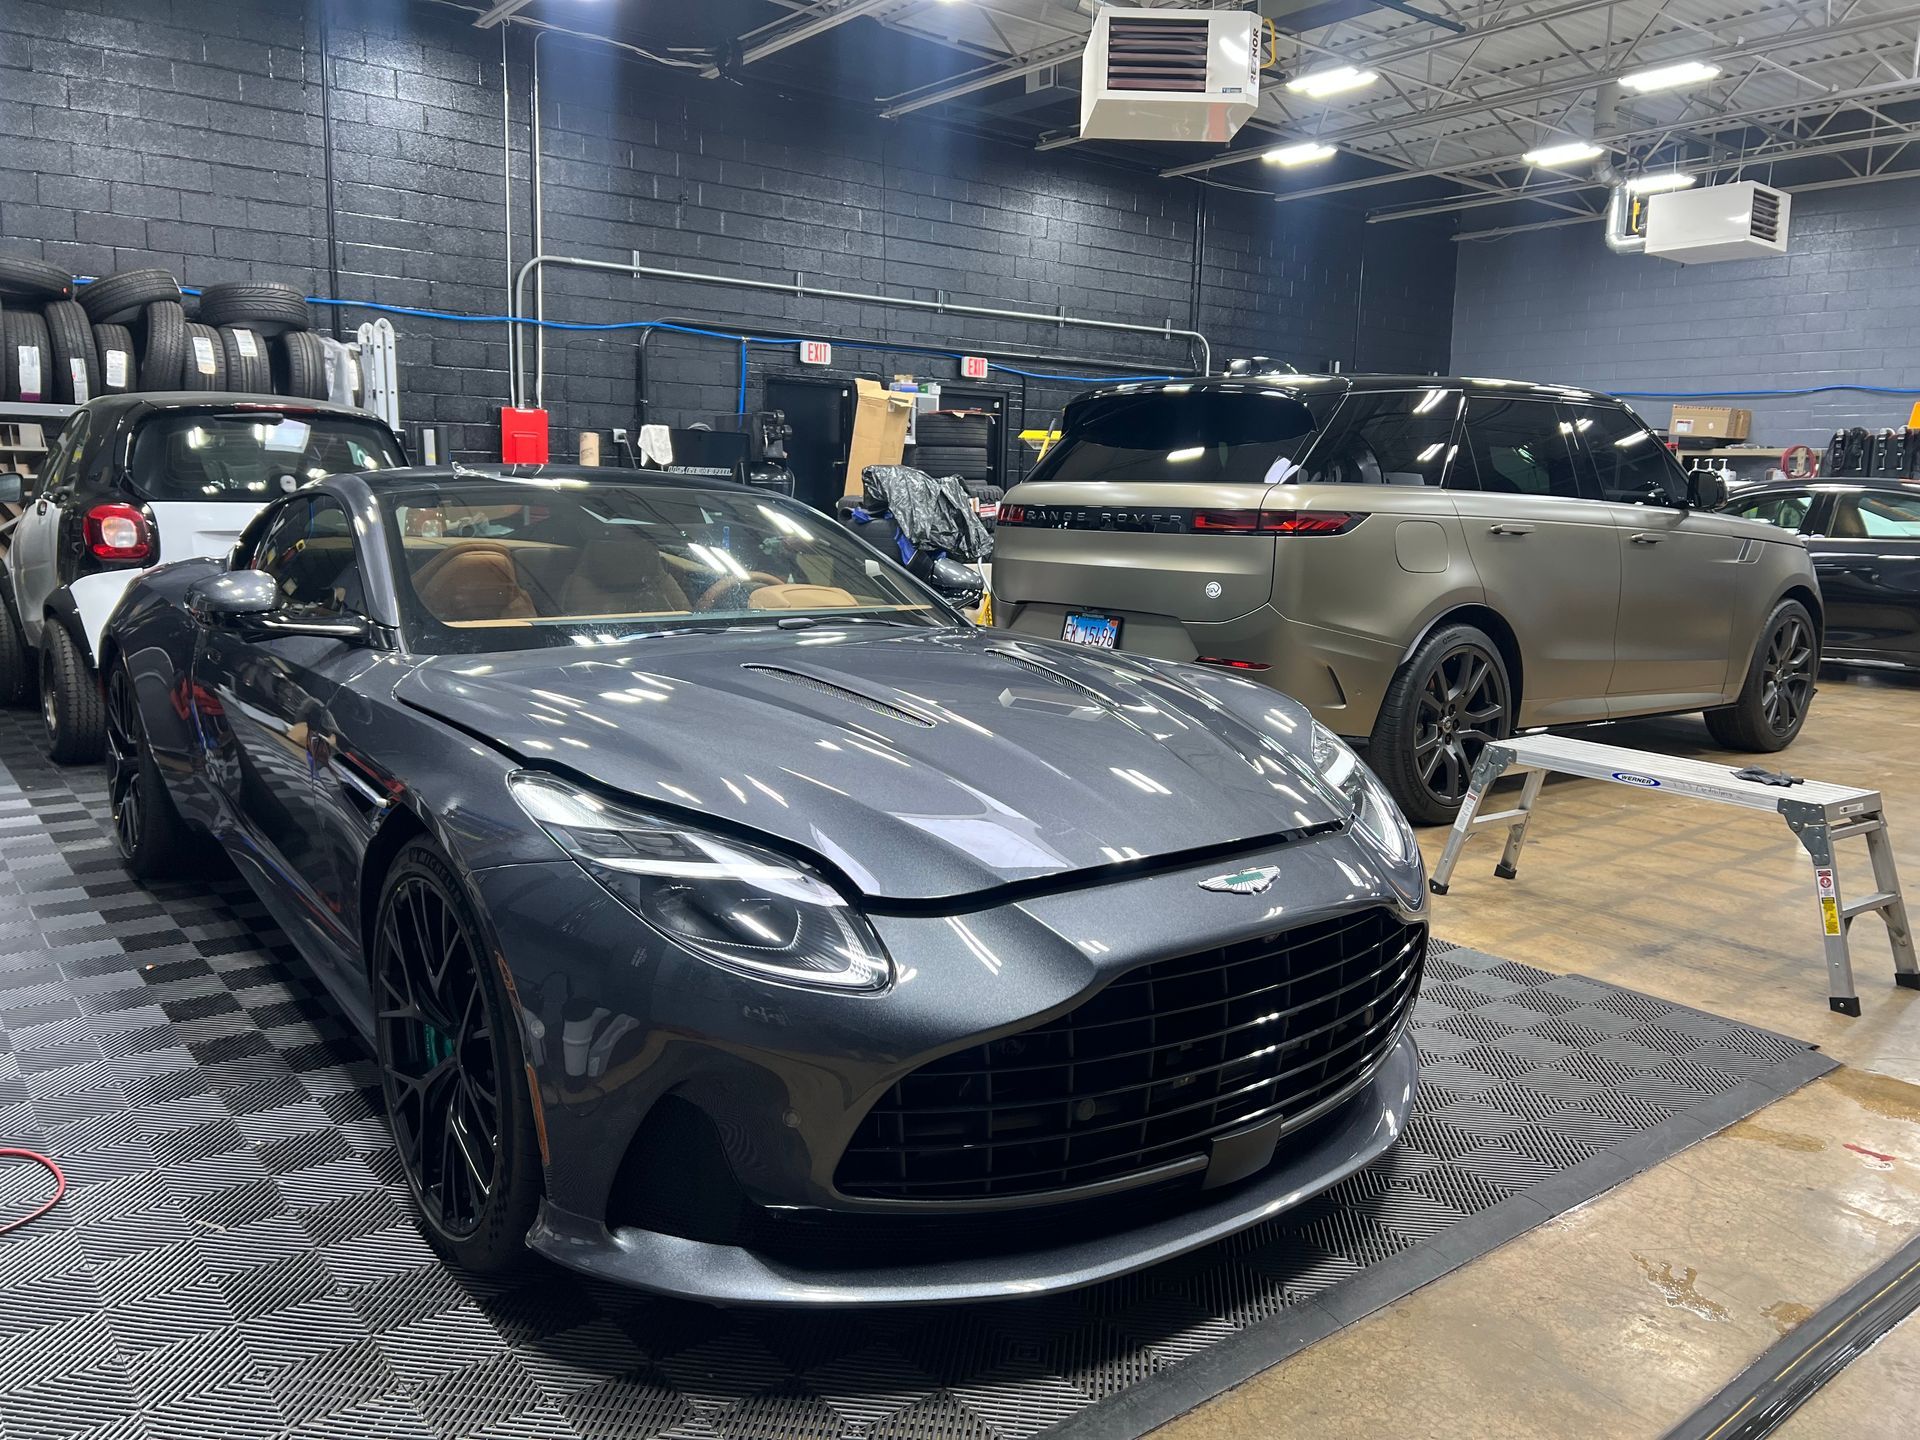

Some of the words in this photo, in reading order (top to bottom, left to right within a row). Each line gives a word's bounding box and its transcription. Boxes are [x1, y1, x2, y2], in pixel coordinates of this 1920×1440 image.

[1250, 27, 1259, 85] REZNOR
[807, 342, 828, 363] EXIT
[967, 358, 985, 377] EXIT
[1026, 510, 1086, 521] RANGE
[1101, 512, 1182, 525] ROVER
[1064, 623, 1078, 643] EK
[1081, 626, 1115, 648] 15496
[1621, 774, 1652, 785] WERNER
[418, 849, 464, 904] MICHELIN
